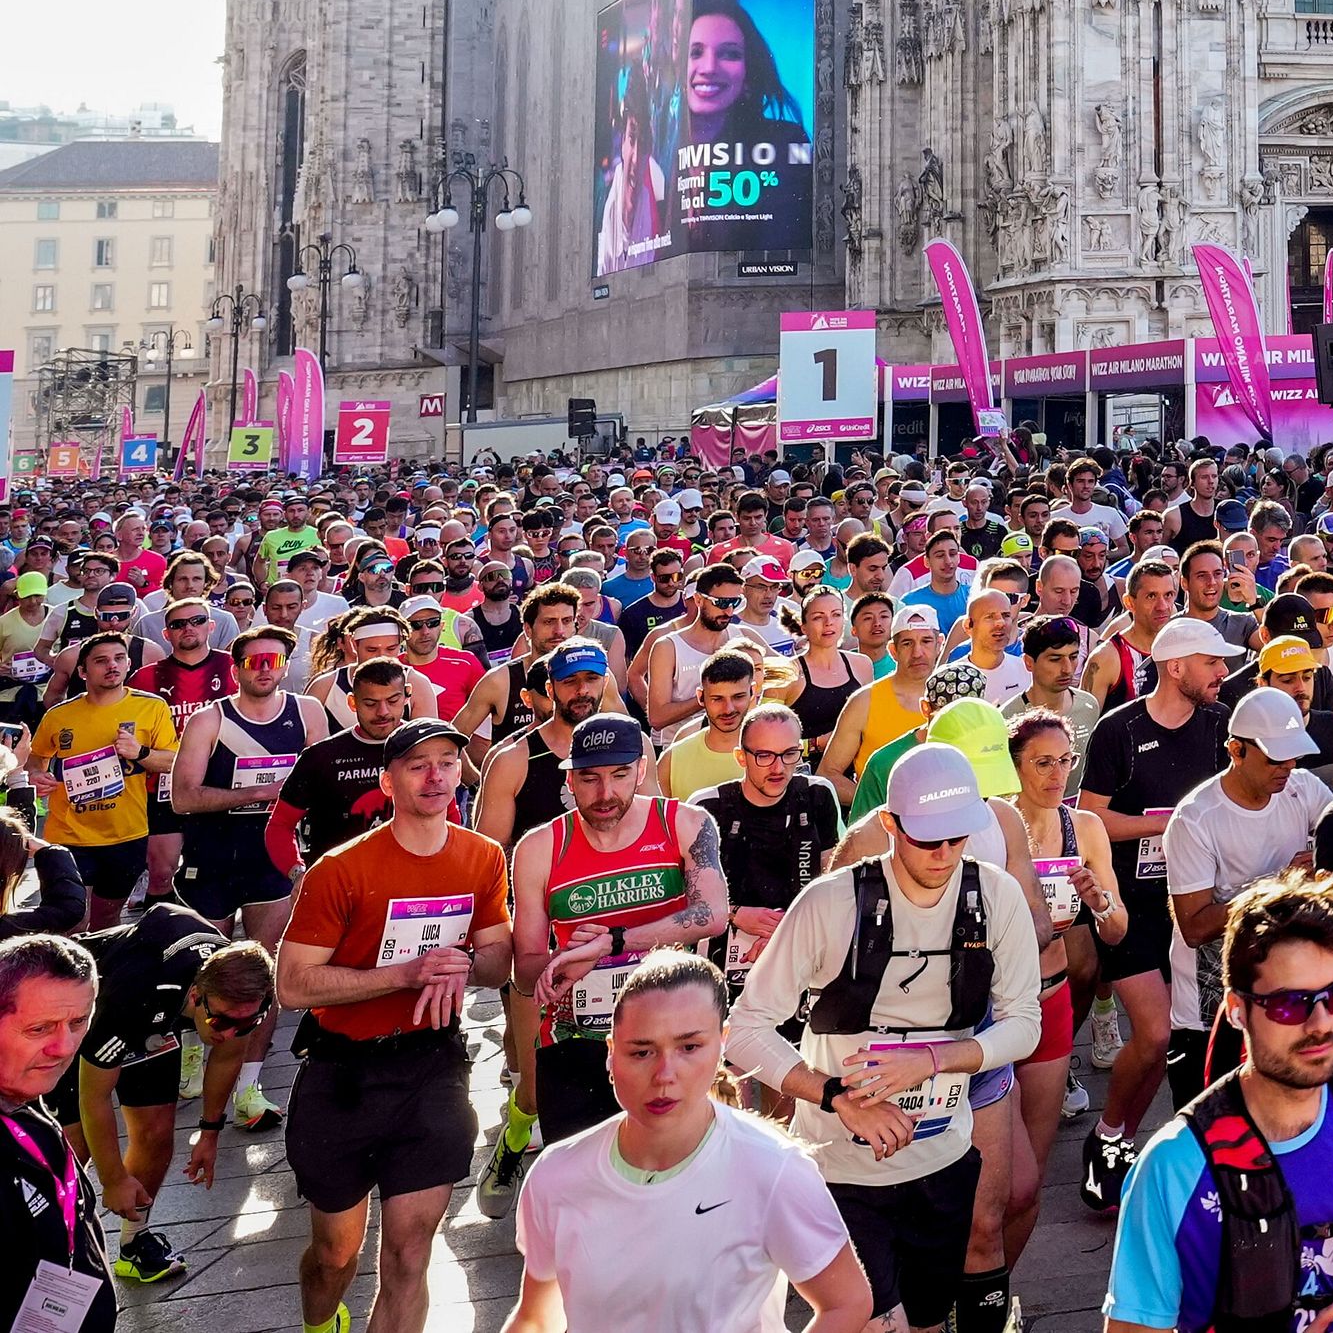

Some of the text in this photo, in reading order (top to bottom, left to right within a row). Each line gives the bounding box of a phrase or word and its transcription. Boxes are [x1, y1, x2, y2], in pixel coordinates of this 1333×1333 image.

[741, 265, 794, 274] URBAN VISION
[1091, 354, 1183, 377] WIZZ AIR MILANO MARATHON
[812, 348, 838, 402] 1
[1270, 389, 1303, 401] WIZZ
[421, 397, 441, 414] M
[351, 418, 375, 446] 2
[130, 444, 149, 462] 4
[242, 434, 260, 456] 3
[18, 456, 30, 471] 6
[56, 450, 72, 467] 5
[282, 540, 304, 549] RUN
[1138, 739, 1160, 753] HOKA
[85, 776, 101, 786] 2207
[255, 772, 276, 785] FREDDIE
[918, 785, 971, 805] SALOMON
[597, 872, 665, 897] ILKLEY
[597, 885, 666, 911] HARRIERS
[422, 924, 441, 941] LUCA
